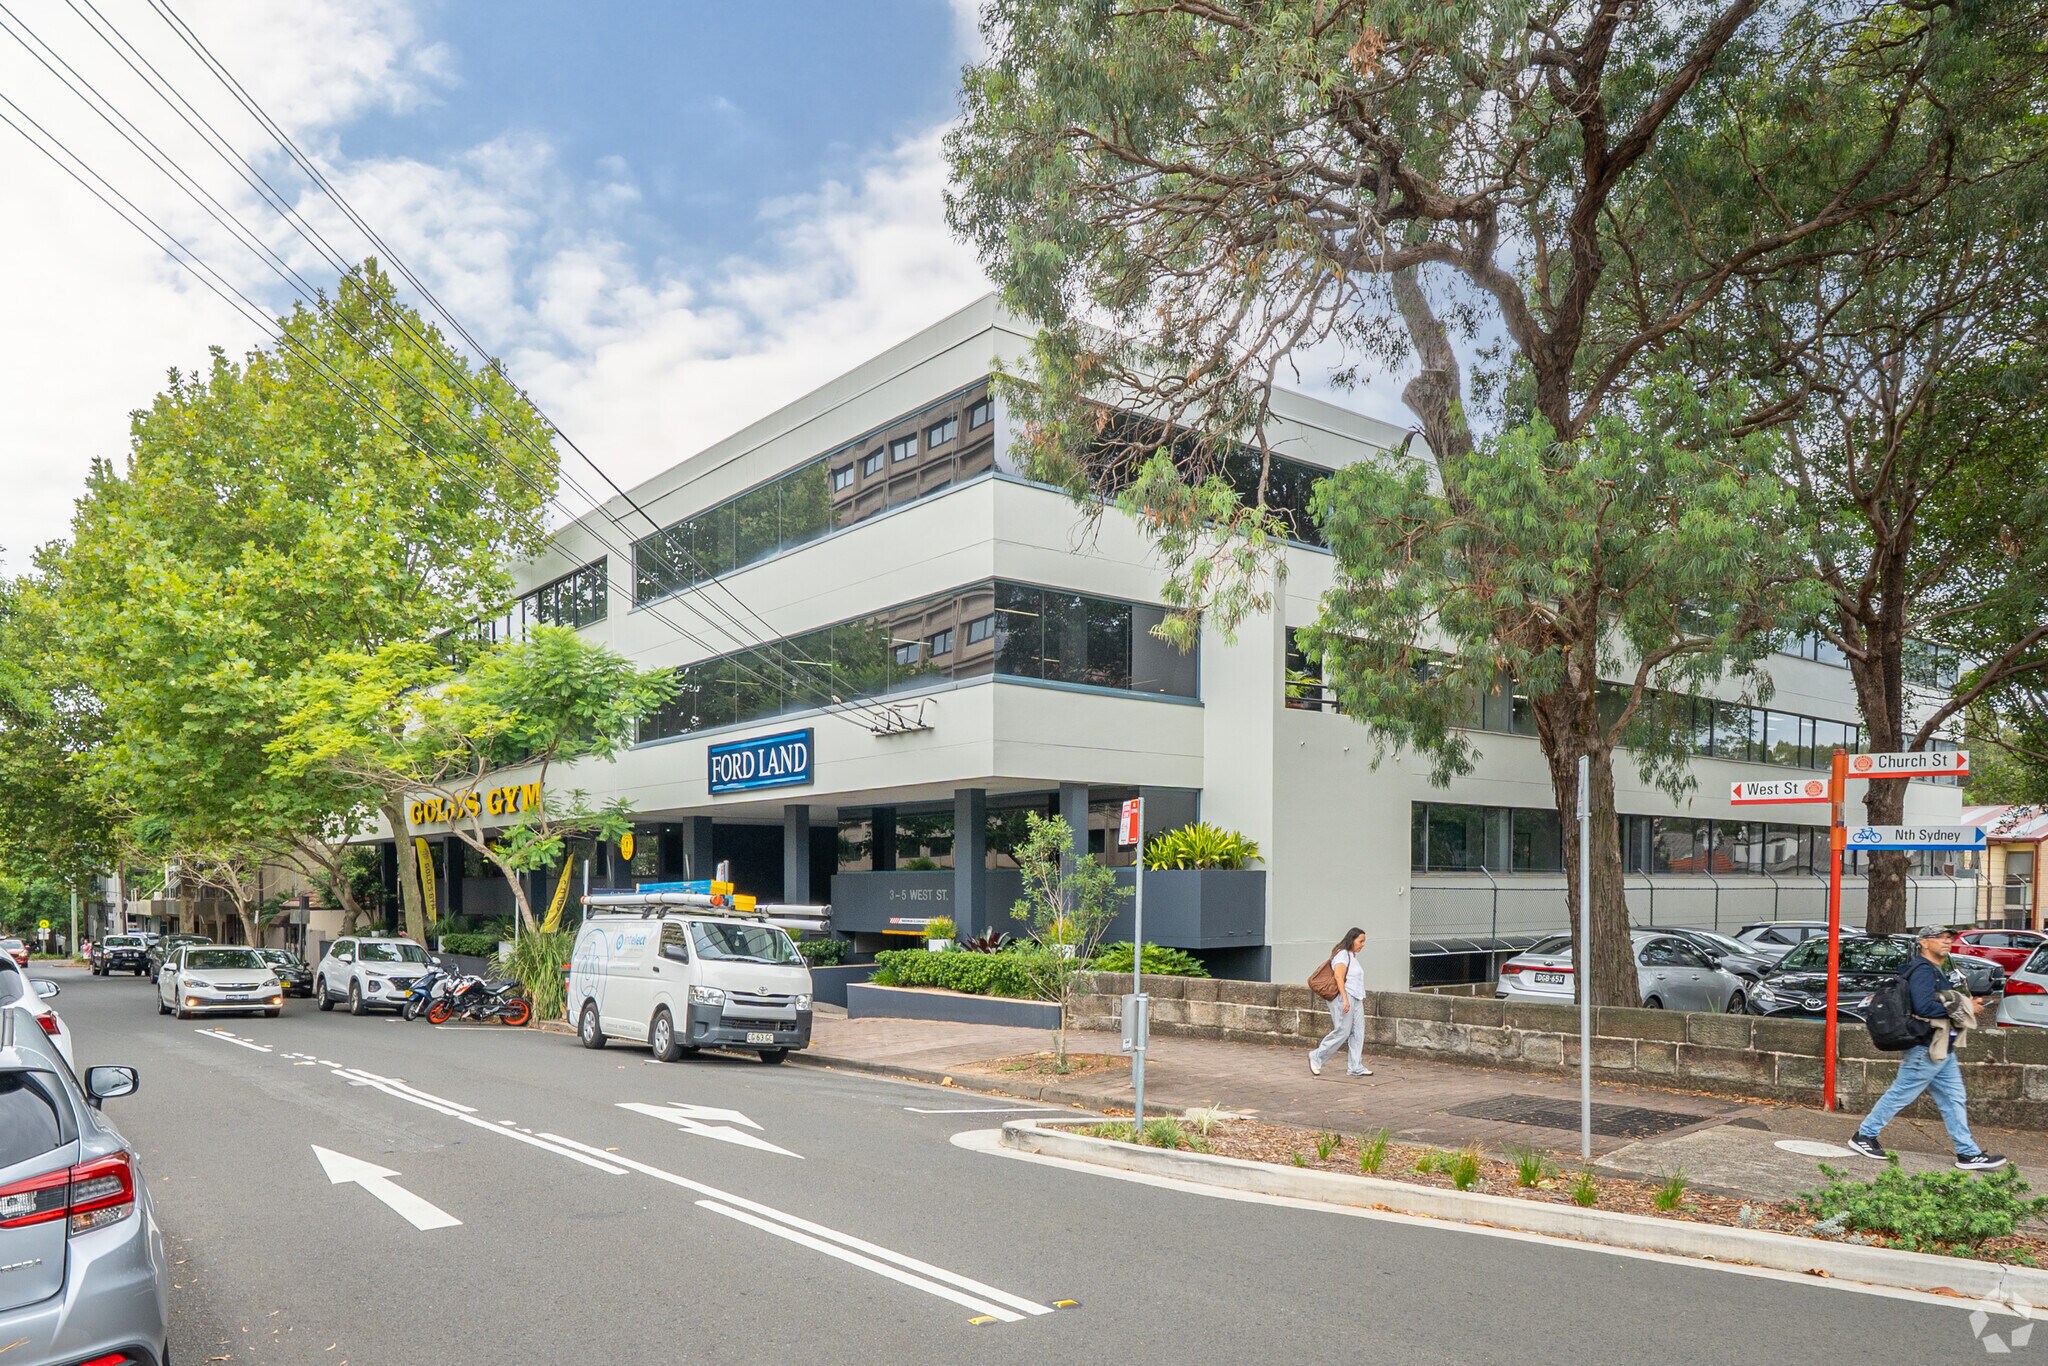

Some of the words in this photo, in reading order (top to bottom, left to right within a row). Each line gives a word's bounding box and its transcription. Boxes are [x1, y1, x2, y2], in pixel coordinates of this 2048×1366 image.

[711, 751, 755, 782] FORD
[758, 743, 807, 776] LAND
[1878, 754, 1927, 768] Church
[1932, 753, 1947, 767] St
[1747, 783, 1779, 796] West
[1783, 781, 1798, 795] St
[487, 781, 544, 816] GYM
[1895, 829, 1915, 841] Nth
[1919, 829, 1961, 843] Sydney
[909, 889, 933, 901] WEST
